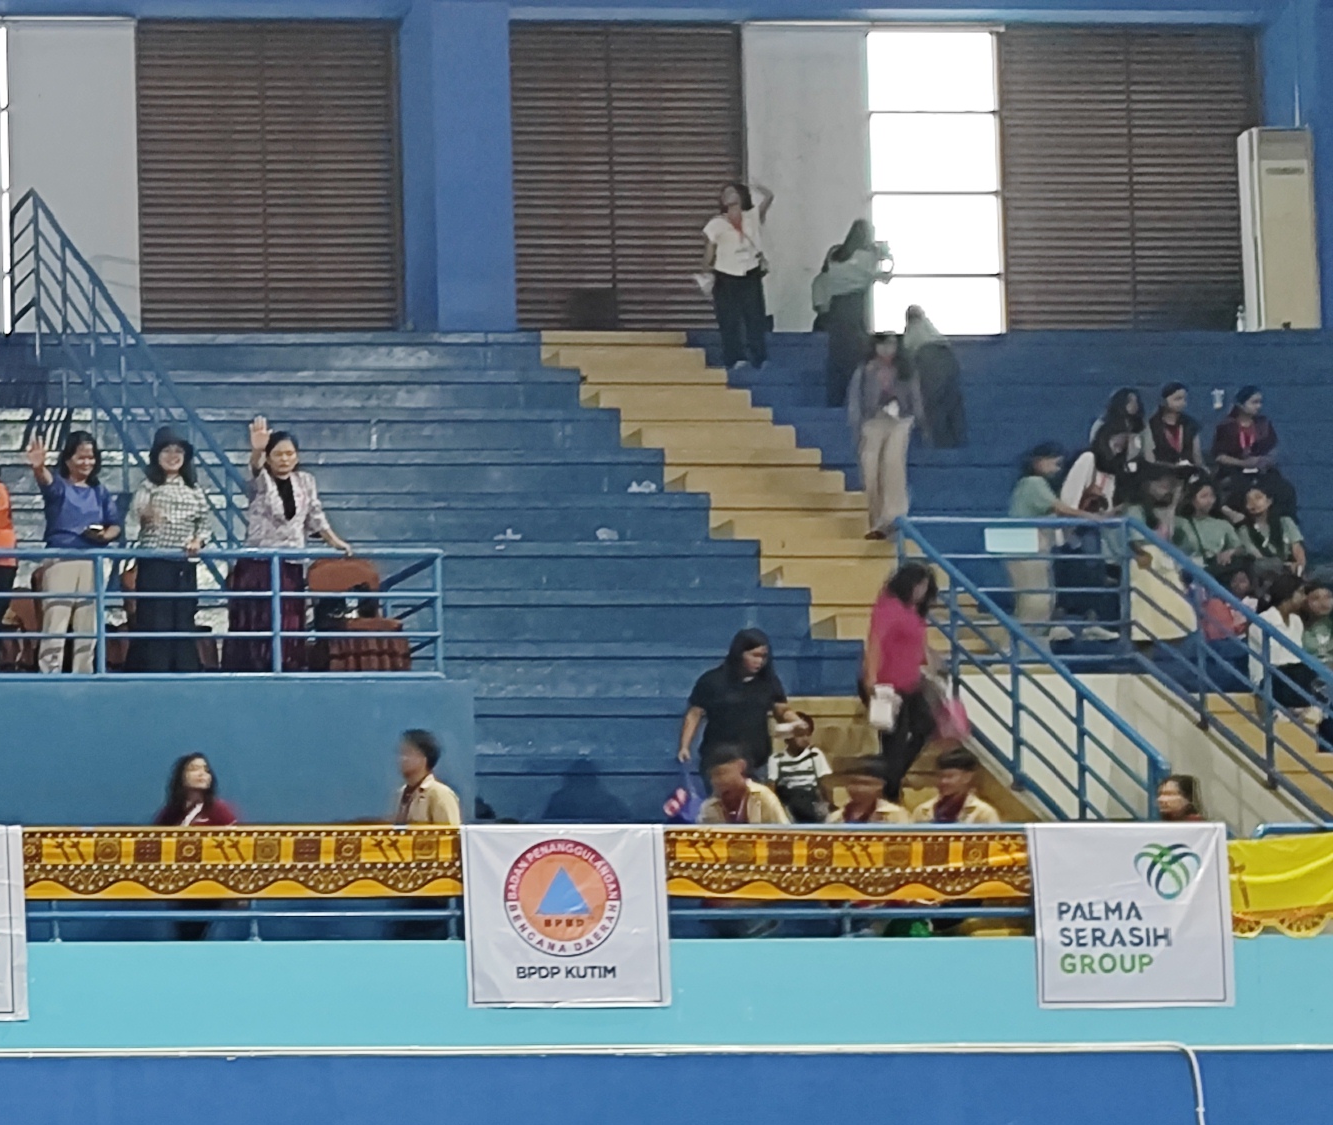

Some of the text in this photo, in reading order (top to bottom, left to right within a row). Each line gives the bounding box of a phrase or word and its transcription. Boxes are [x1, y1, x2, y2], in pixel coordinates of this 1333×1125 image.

[506, 842, 619, 901] BADAN PENANGGULANGAN
[1057, 902, 1143, 921] PALMA
[507, 903, 618, 953] BENCANA DAERAH
[1059, 927, 1172, 947] SERASIH
[516, 966, 617, 979] BPDP KUTIM
[1060, 953, 1153, 974] GROUP
